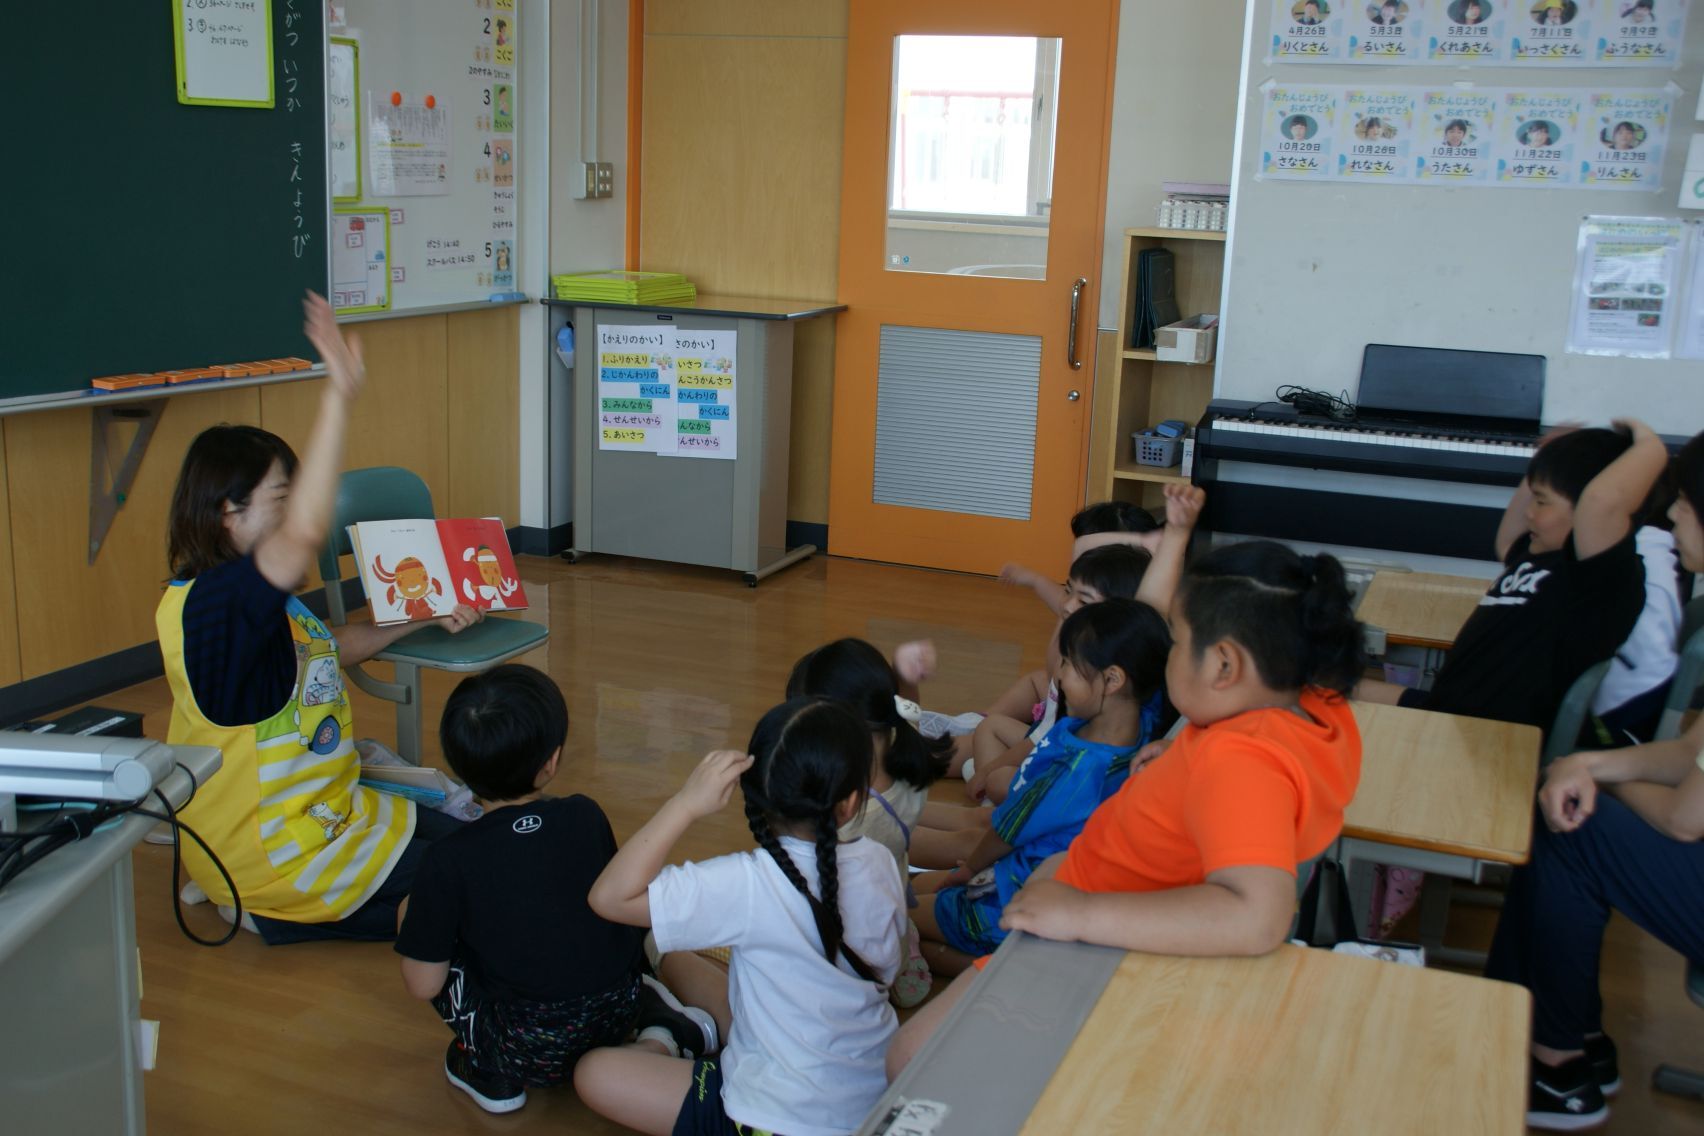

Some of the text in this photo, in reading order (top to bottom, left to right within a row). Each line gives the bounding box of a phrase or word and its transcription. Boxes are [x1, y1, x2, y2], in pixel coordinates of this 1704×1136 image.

[483, 17, 491, 34] 2
[1288, 26, 1326, 36] 4月26日
[1370, 26, 1403, 36] 5月3日
[1447, 26, 1488, 36] 5月21日
[1620, 26, 1657, 36] 9月9日
[1530, 28, 1572, 37] 7月11日
[1283, 41, 1329, 53] りくとさん
[1363, 41, 1406, 53] るいさん
[1439, 41, 1494, 54] くれあさん
[1606, 43, 1666, 55] ふうなさん
[283, 59, 301, 112] いつか
[483, 88, 491, 105] 3
[483, 142, 491, 158] 4
[1279, 143, 1321, 151] 10月20日
[1432, 147, 1477, 157] 10月30日
[1514, 150, 1561, 159] 11月22日
[1597, 151, 1646, 160] 11月23日
[1278, 156, 1318, 168] さなさん
[1351, 159, 1394, 171] れなさん
[1431, 162, 1473, 173] うたさん
[1513, 165, 1559, 176] ゆずさん
[1597, 167, 1641, 178] りんさん
[290, 142, 311, 258] きんようび
[485, 242, 492, 258] 5
[602, 333, 664, 345] 【かえりのかい】
[640, 385, 670, 395] かくにん
[699, 408, 729, 417] かくにん
